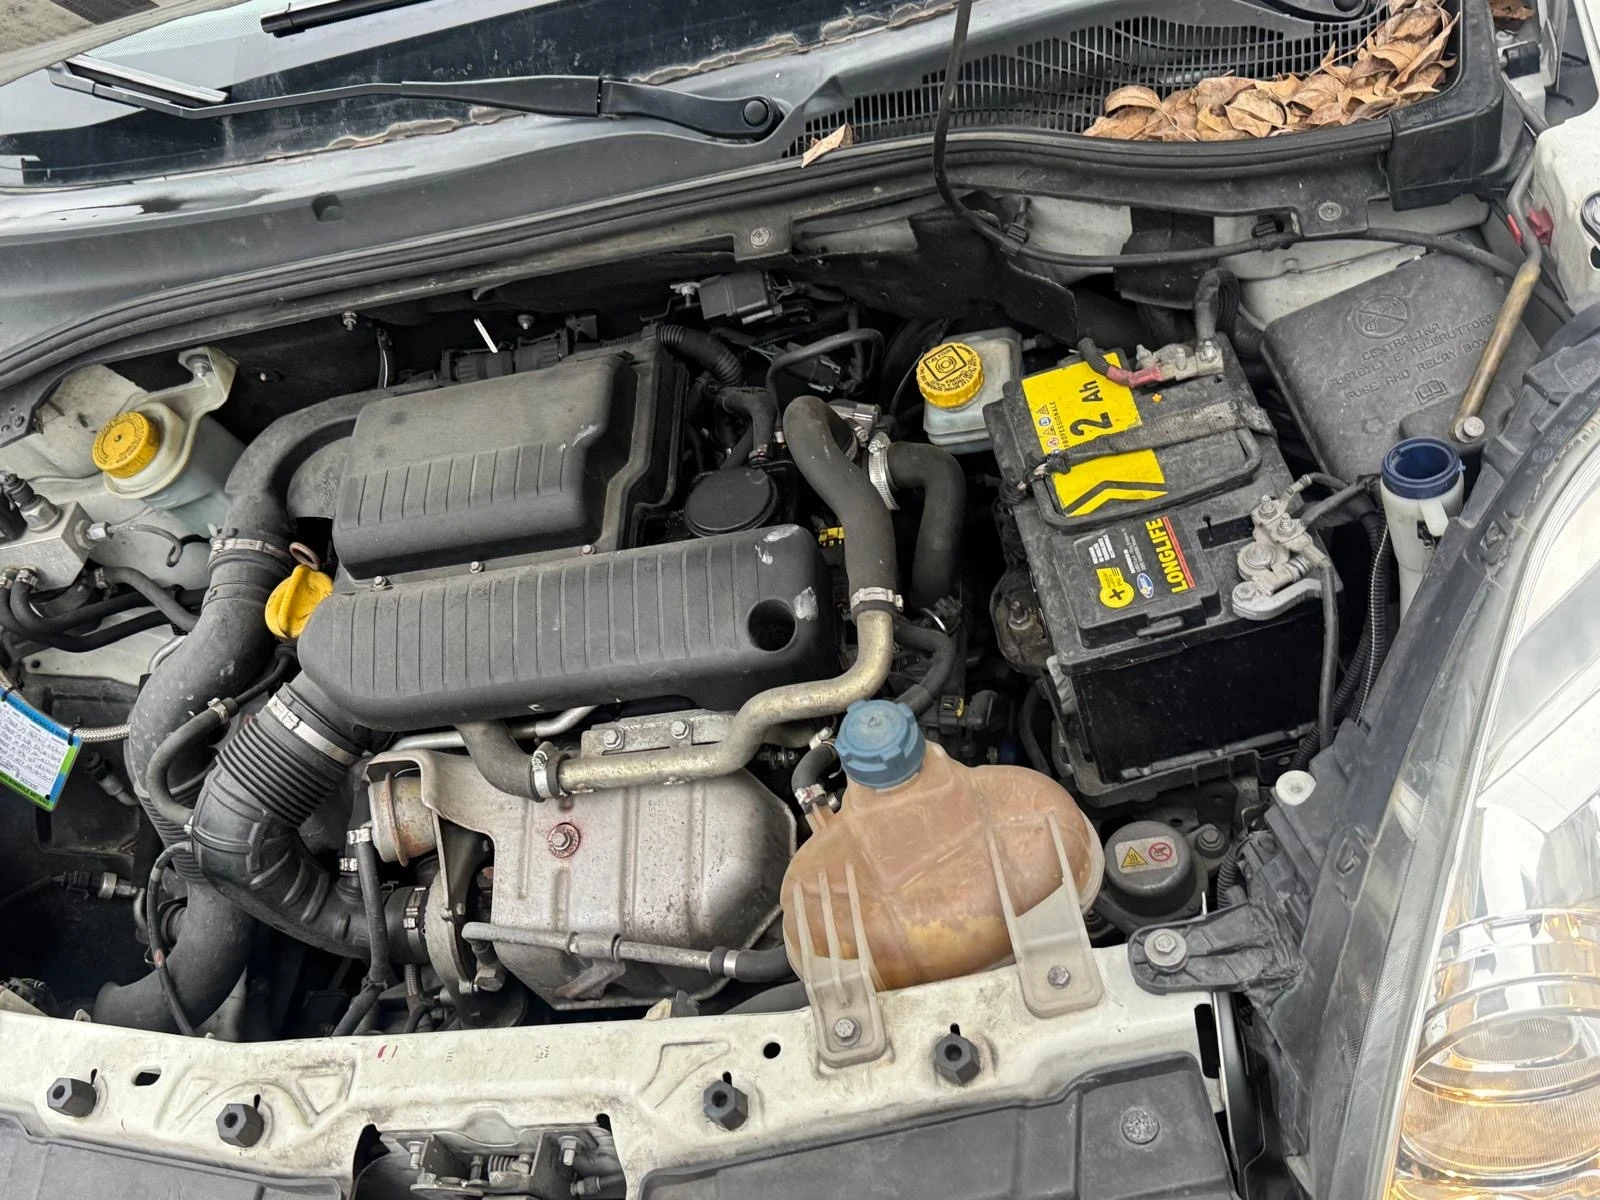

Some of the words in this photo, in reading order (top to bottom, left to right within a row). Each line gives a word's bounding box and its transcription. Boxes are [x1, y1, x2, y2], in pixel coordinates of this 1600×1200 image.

[1361, 322, 1441, 361] CENTRALINA
[1326, 359, 1386, 389] FUSIBILI
[1393, 352, 1403, 362] E
[1344, 381, 1381, 401] FUSE
[1385, 369, 1411, 386] AND
[1416, 349, 1457, 373] RELAY
[1462, 335, 1489, 353] BOX
[1079, 380, 1103, 402] Ah
[1049, 401, 1070, 448] PROFESSIONALE
[1145, 518, 1189, 593] LONGLIFE
